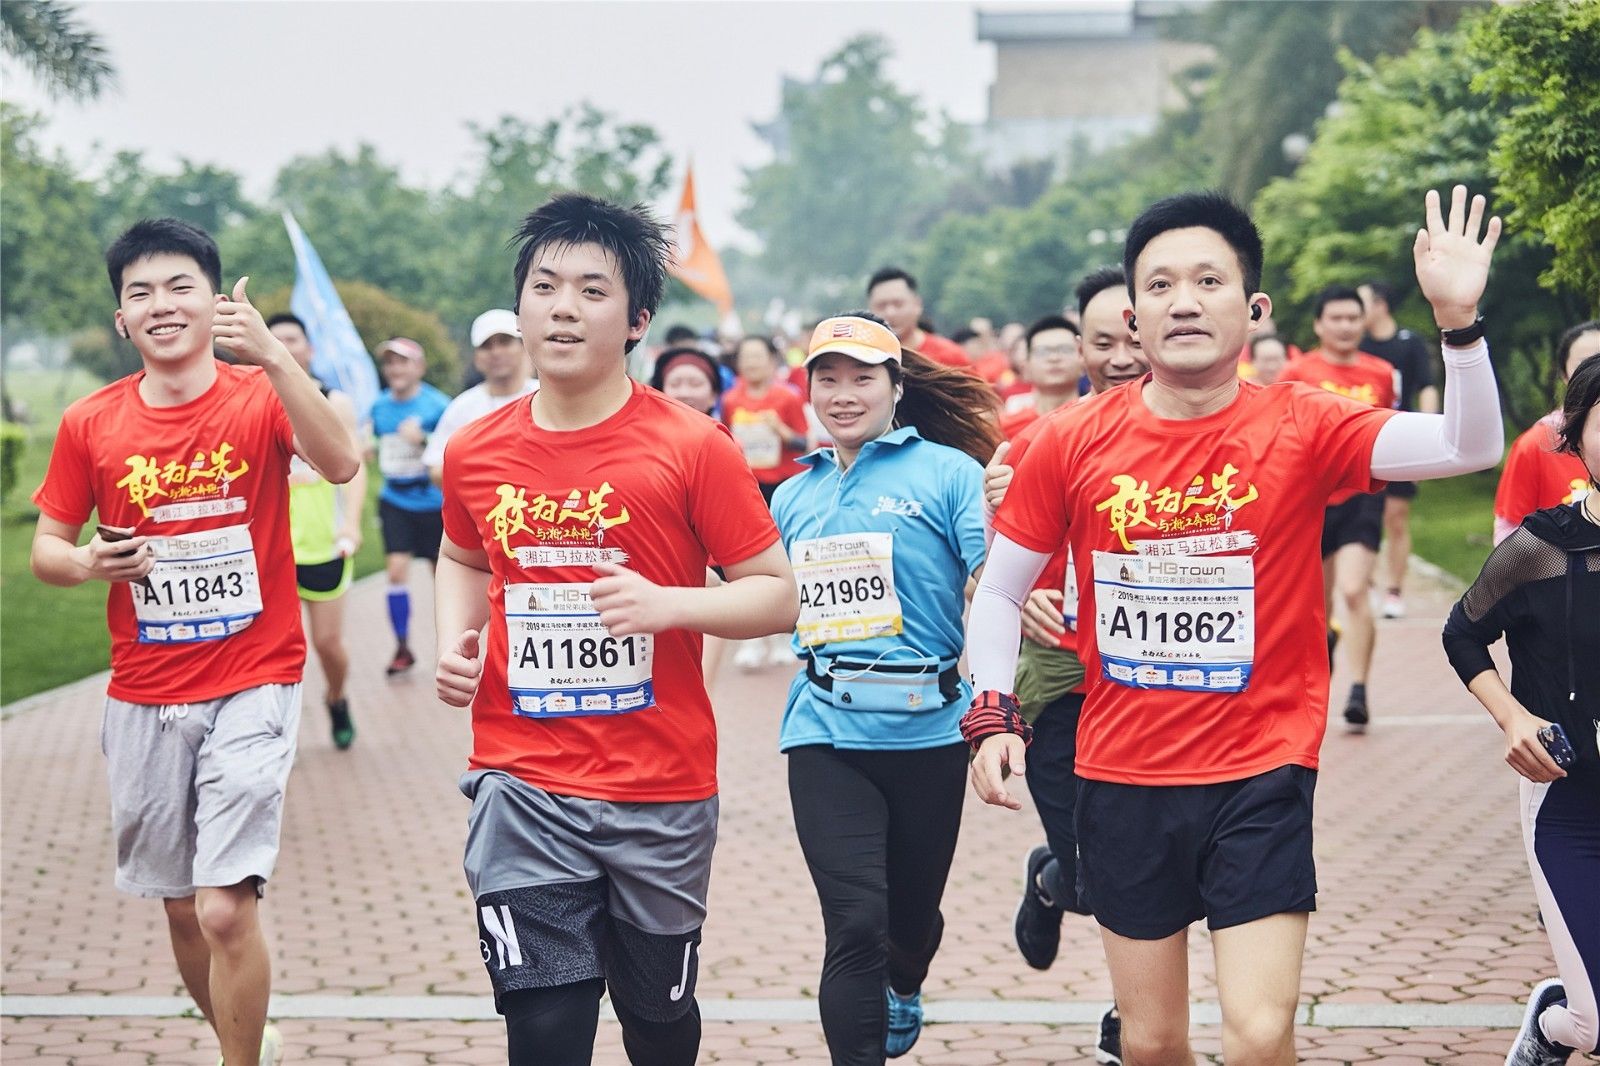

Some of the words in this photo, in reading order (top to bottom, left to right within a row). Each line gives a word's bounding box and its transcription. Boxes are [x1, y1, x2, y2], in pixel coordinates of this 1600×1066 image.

[116, 442, 249, 518] 敢为人先
[486, 482, 630, 559] 敢为人先
[1096, 463, 1258, 551] 敢为人先
[525, 550, 613, 564] 湘江马拉松赛
[1145, 535, 1239, 557] 湘江马拉松赛
[144, 572, 244, 606] A11843
[800, 576, 885, 609] A21969
[1109, 606, 1235, 643] A11862
[519, 636, 636, 669] A11861
[481, 905, 523, 970] N
[670, 941, 693, 1002] J
